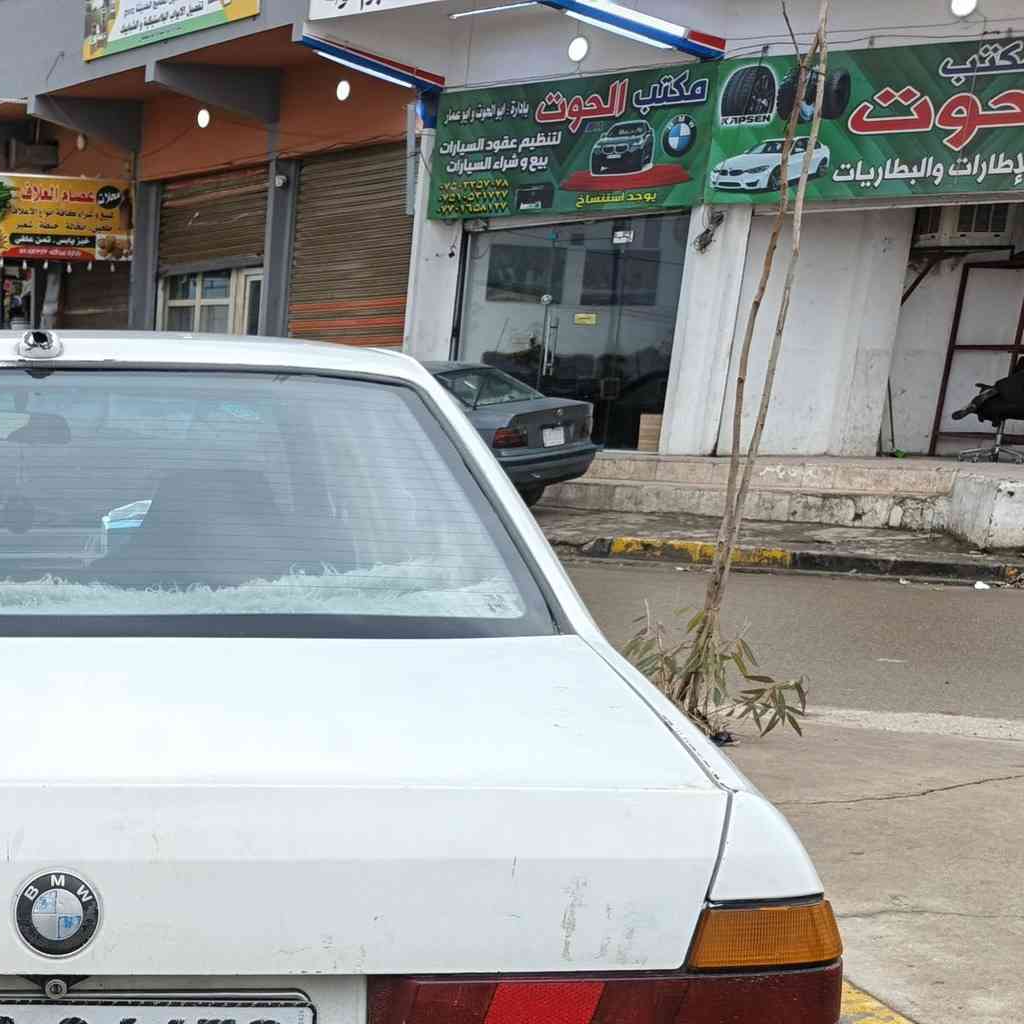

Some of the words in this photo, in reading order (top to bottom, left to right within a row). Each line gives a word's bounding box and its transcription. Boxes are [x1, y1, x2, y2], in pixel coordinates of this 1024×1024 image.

[939, 40, 1024, 86] كتب
[632, 69, 709, 116] مكتب
[535, 78, 628, 133] الحوت
[720, 114, 772, 126] KAPSEN
[848, 86, 1024, 151] حوت
[439, 138, 485, 157] السيارات
[485, 135, 518, 154] عقود
[518, 131, 563, 153] لتنظيم
[446, 156, 491, 175] السيارات
[492, 153, 519, 171] شراء
[529, 155, 549, 172] بيع
[832, 155, 944, 187] والبطاريات
[575, 191, 625, 208] استنساخ
[24, 874, 93, 903] BMW
